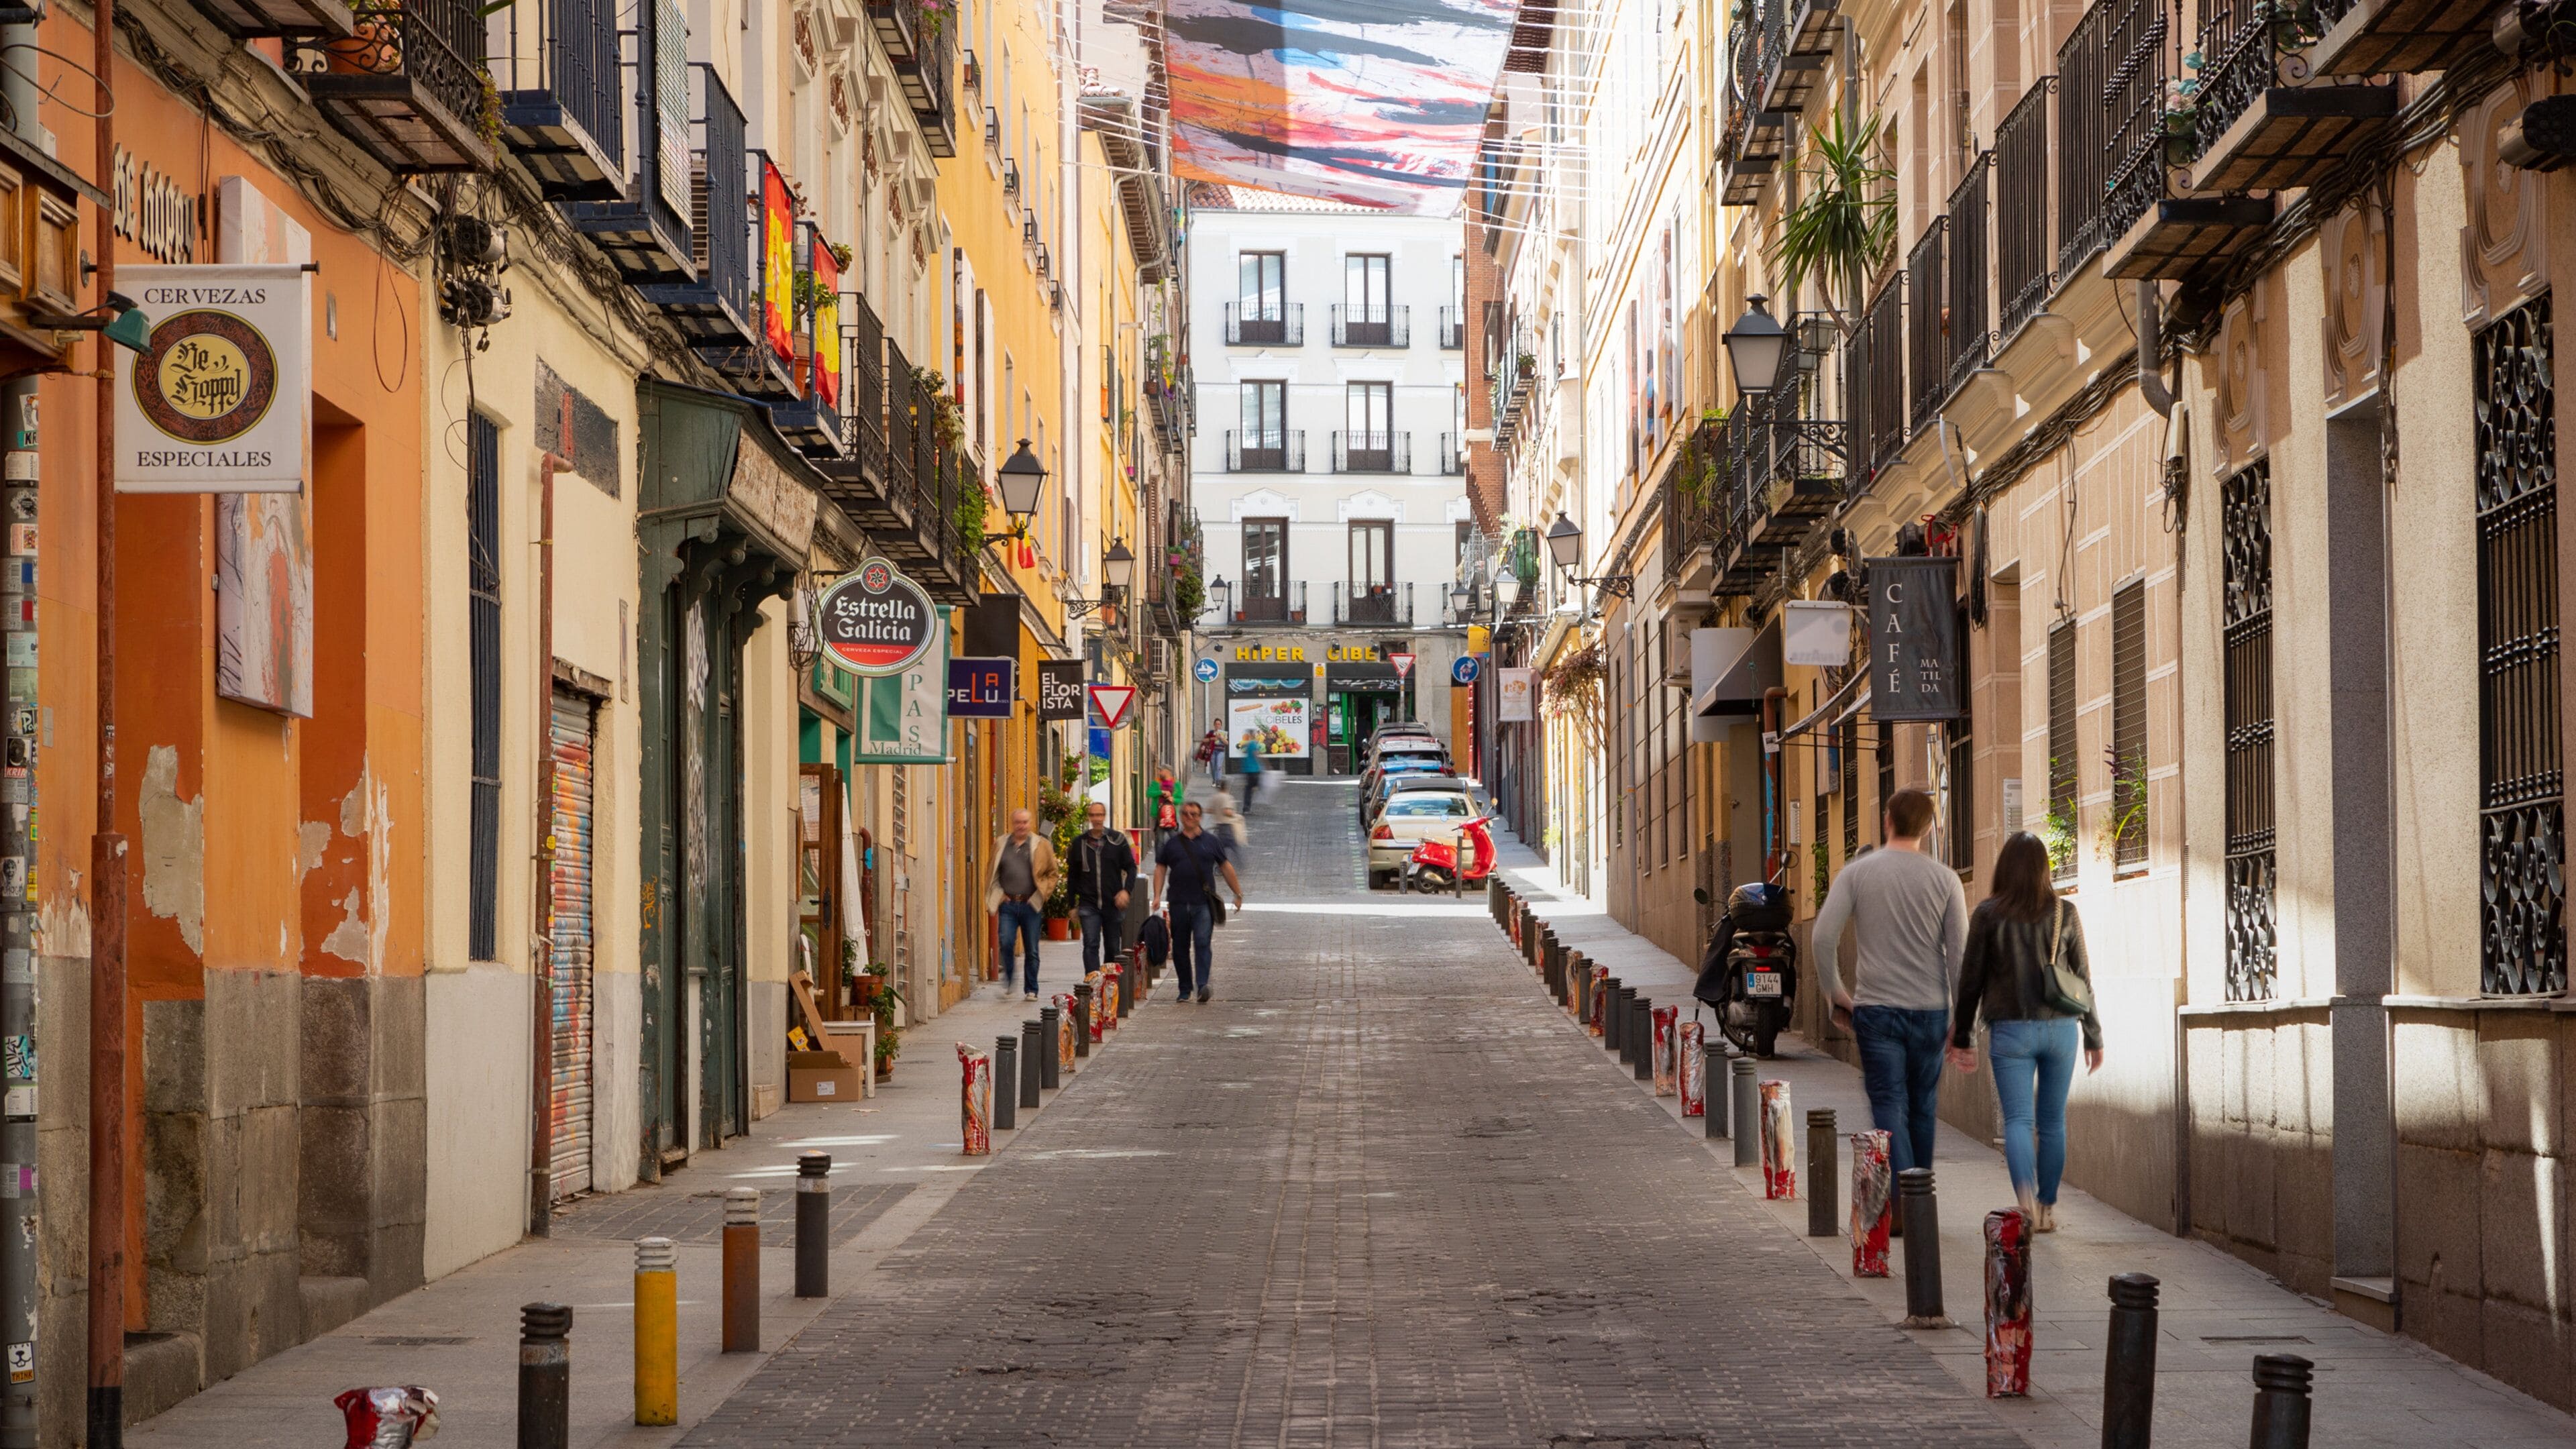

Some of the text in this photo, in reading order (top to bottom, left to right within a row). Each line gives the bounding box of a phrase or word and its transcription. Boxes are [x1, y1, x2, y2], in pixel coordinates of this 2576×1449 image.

[144, 288, 266, 304] CERVEZAS
[137, 451, 272, 467] ESPECIALES
[834, 595, 916, 620] Estrella
[837, 617, 911, 641] Galicia
[1885, 582, 1902, 694] CAFÉ
[1236, 647, 1305, 661] HIPER
[1921, 659, 1939, 667] MA
[1042, 672, 1060, 684] EL
[1921, 671, 1941, 680] TIL
[1042, 684, 1081, 697] FLOR
[1921, 684, 1939, 693] DA
[1042, 697, 1073, 709] ISTA
[1266, 715, 1302, 724] CIBELES
[869, 741, 922, 755] Madrid
[1756, 974, 1778, 983] 9144
[1756, 983, 1774, 993] GMH
[11, 1370, 33, 1382] THINK
